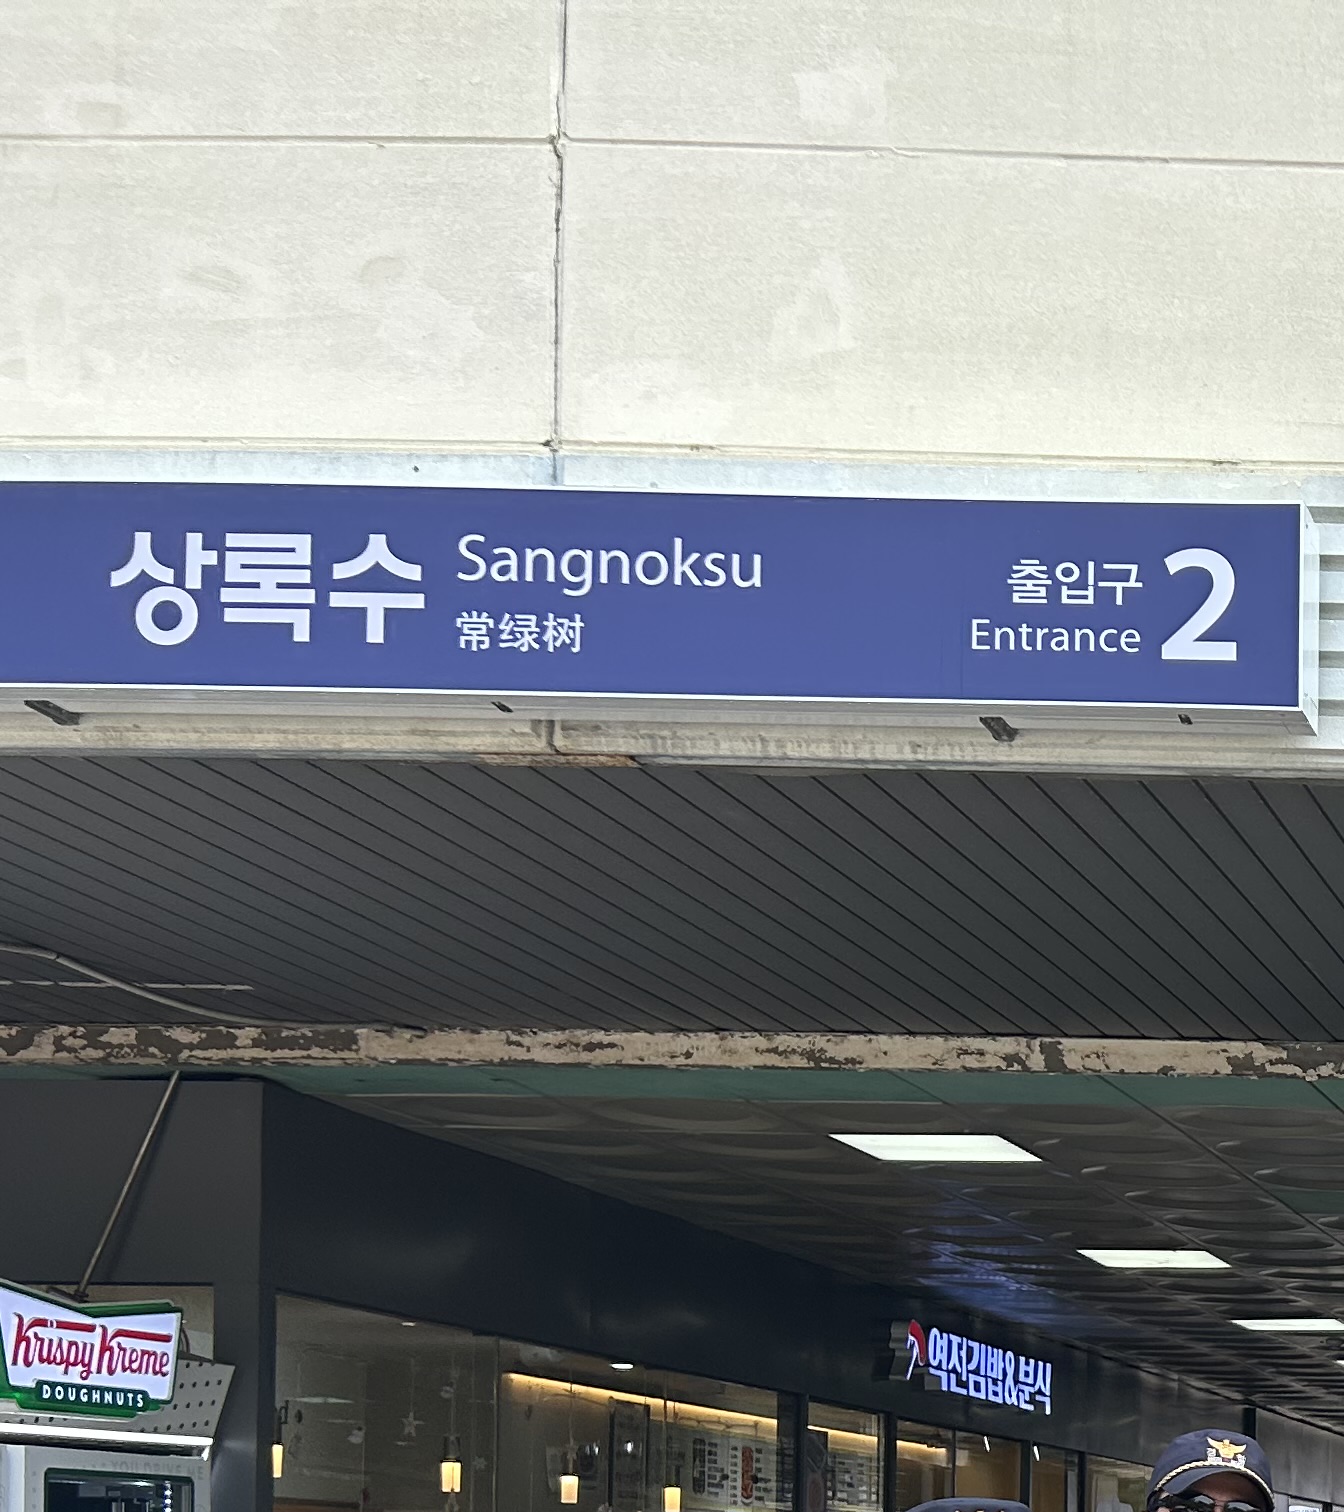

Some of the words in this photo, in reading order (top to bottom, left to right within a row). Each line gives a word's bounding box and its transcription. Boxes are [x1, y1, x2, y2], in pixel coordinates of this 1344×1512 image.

[110, 531, 425, 646] 상록수
[456, 534, 762, 597] Sangnoksu
[1007, 559, 1143, 605] 출입구
[455, 610, 585, 653] 常绿树
[971, 618, 1141, 652] Entrance
[1161, 547, 1237, 661] 2
[11, 1312, 96, 1380] Krispy
[96, 1324, 173, 1377] Kreme
[928, 1327, 1052, 1415] 역전김밥&분식
[42, 1385, 144, 1408] DOUGHNUTS
